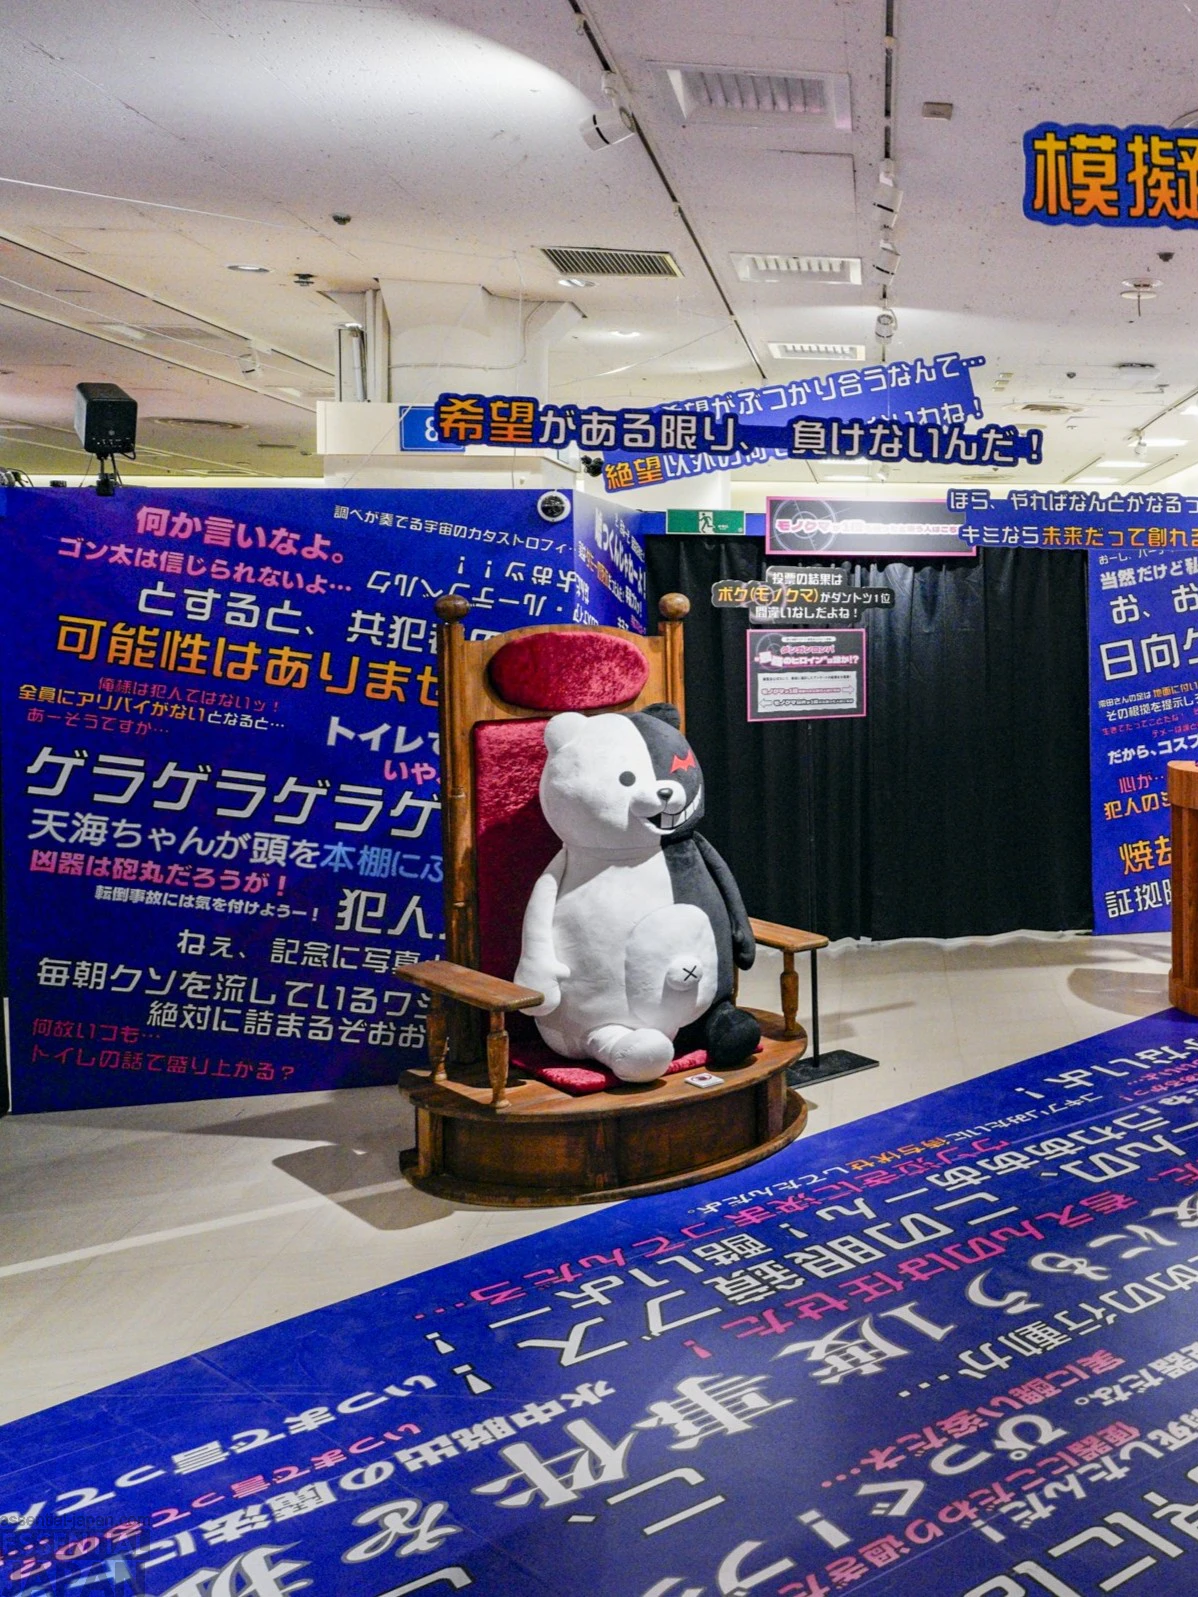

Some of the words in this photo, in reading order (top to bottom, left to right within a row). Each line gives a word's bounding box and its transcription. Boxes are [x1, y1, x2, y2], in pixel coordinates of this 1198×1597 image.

[664, 354, 986, 414] 望がぶつかり合うなんて…
[437, 397, 1045, 462] 希望がある限り、負けないんだ！
[136, 505, 345, 565] 何か言いなよ。
[58, 536, 352, 594] ゴン太は信じられないよ…
[770, 571, 843, 586] 投票の結果は
[137, 580, 440, 655] とすると、共犯
[755, 604, 859, 620] 間違いなしだよね！
[29, 849, 287, 898] 凶器は砲丸だろうが！
[94, 884, 320, 923] 転倒事故には気を付けようー！
[334, 887, 446, 941] 犯人
[1105, 880, 1171, 919] 証拠
[177, 929, 440, 975] ねえ、記念に写真
[32, 1017, 161, 1042] 何故いつも…
[146, 1000, 427, 1050] 絶対に詰まるぞおお
